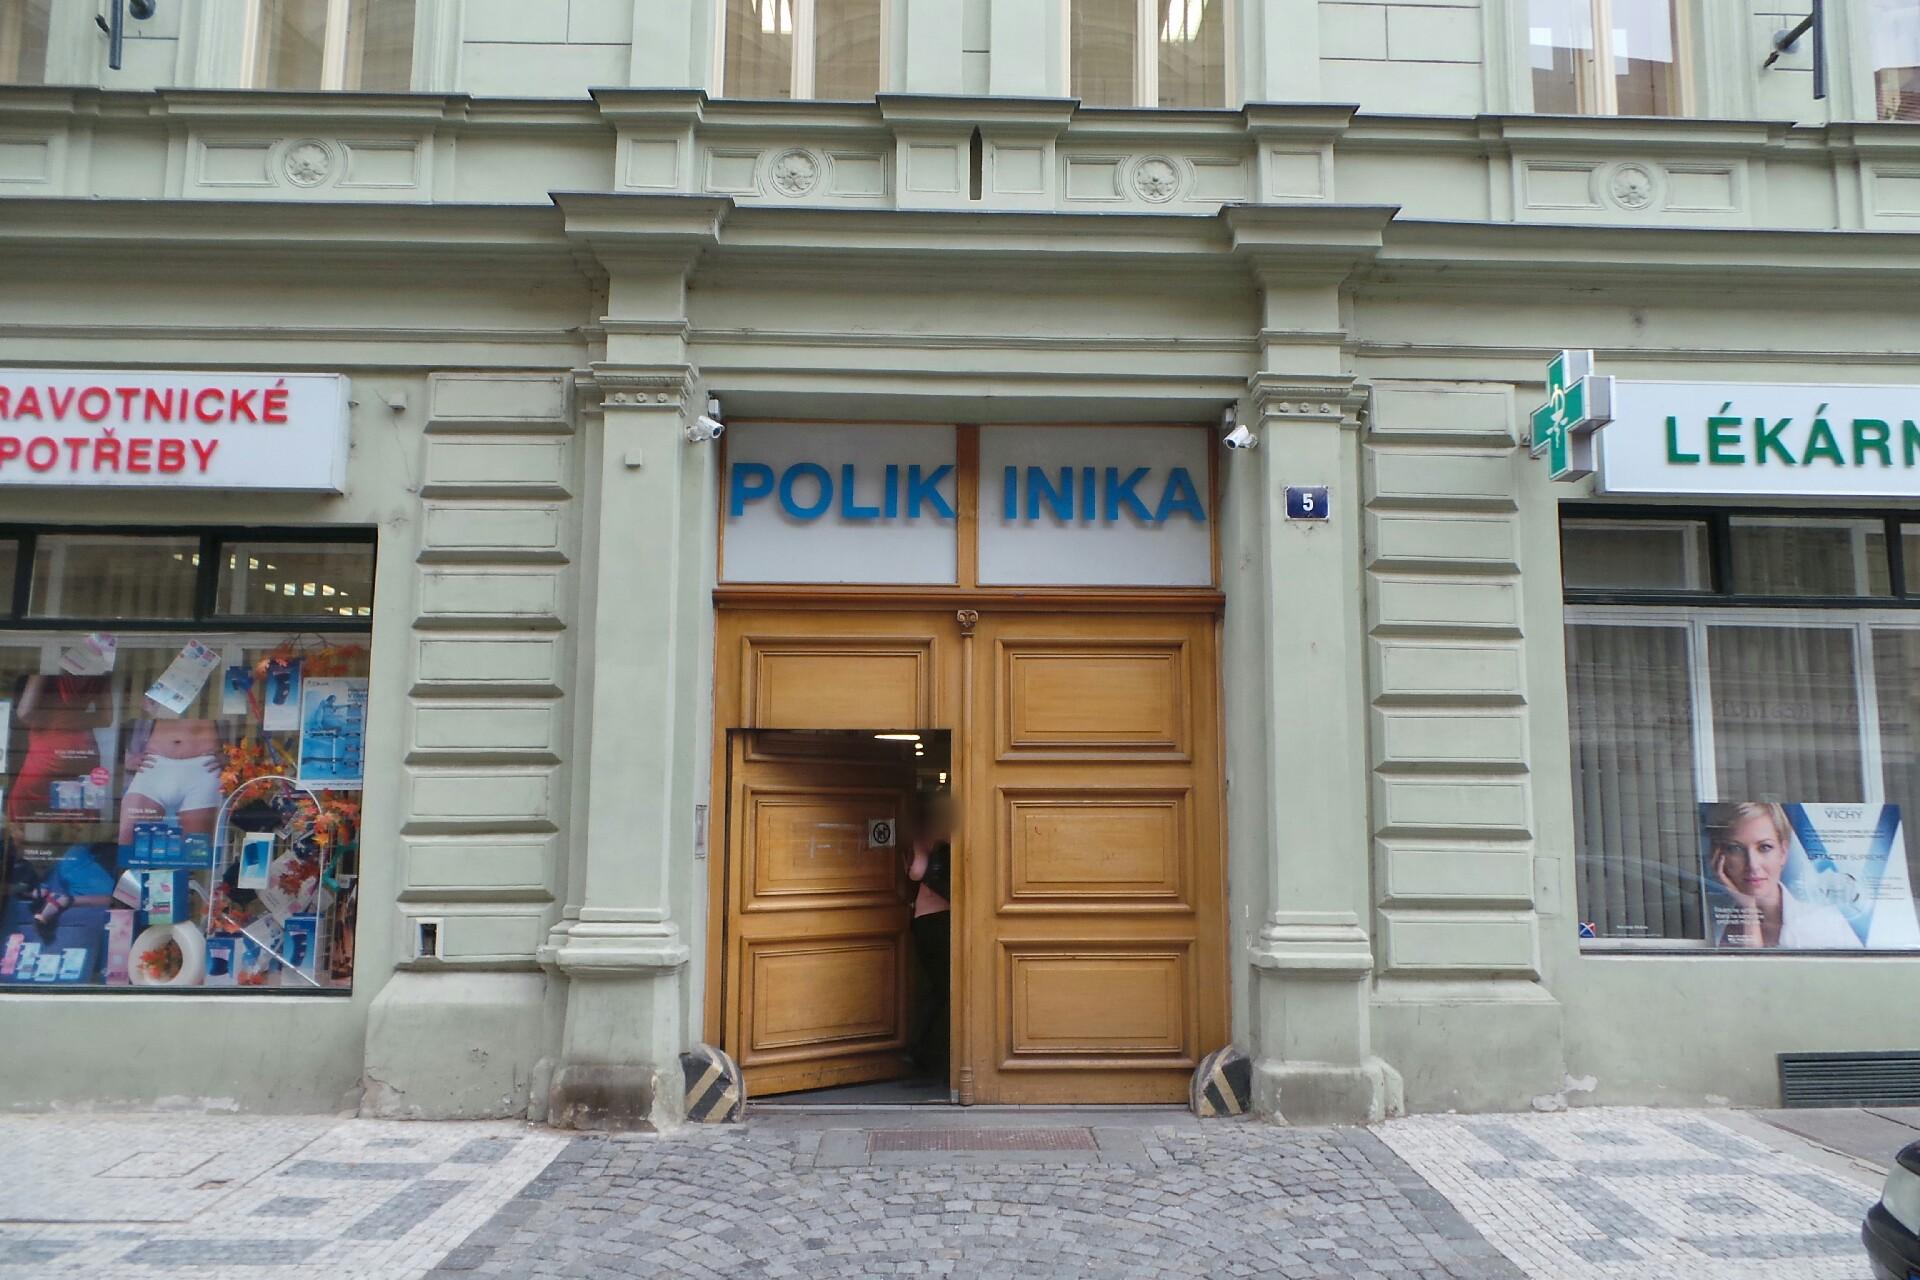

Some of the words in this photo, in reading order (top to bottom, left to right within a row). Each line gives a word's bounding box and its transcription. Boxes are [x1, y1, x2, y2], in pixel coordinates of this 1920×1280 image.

[0, 428, 218, 473] POTŘEBY
[730, 463, 956, 520] POLIK
[1004, 466, 1205, 522] INIKA
[1302, 493, 1314, 511] 5
[1824, 810, 1863, 819] VICHY
